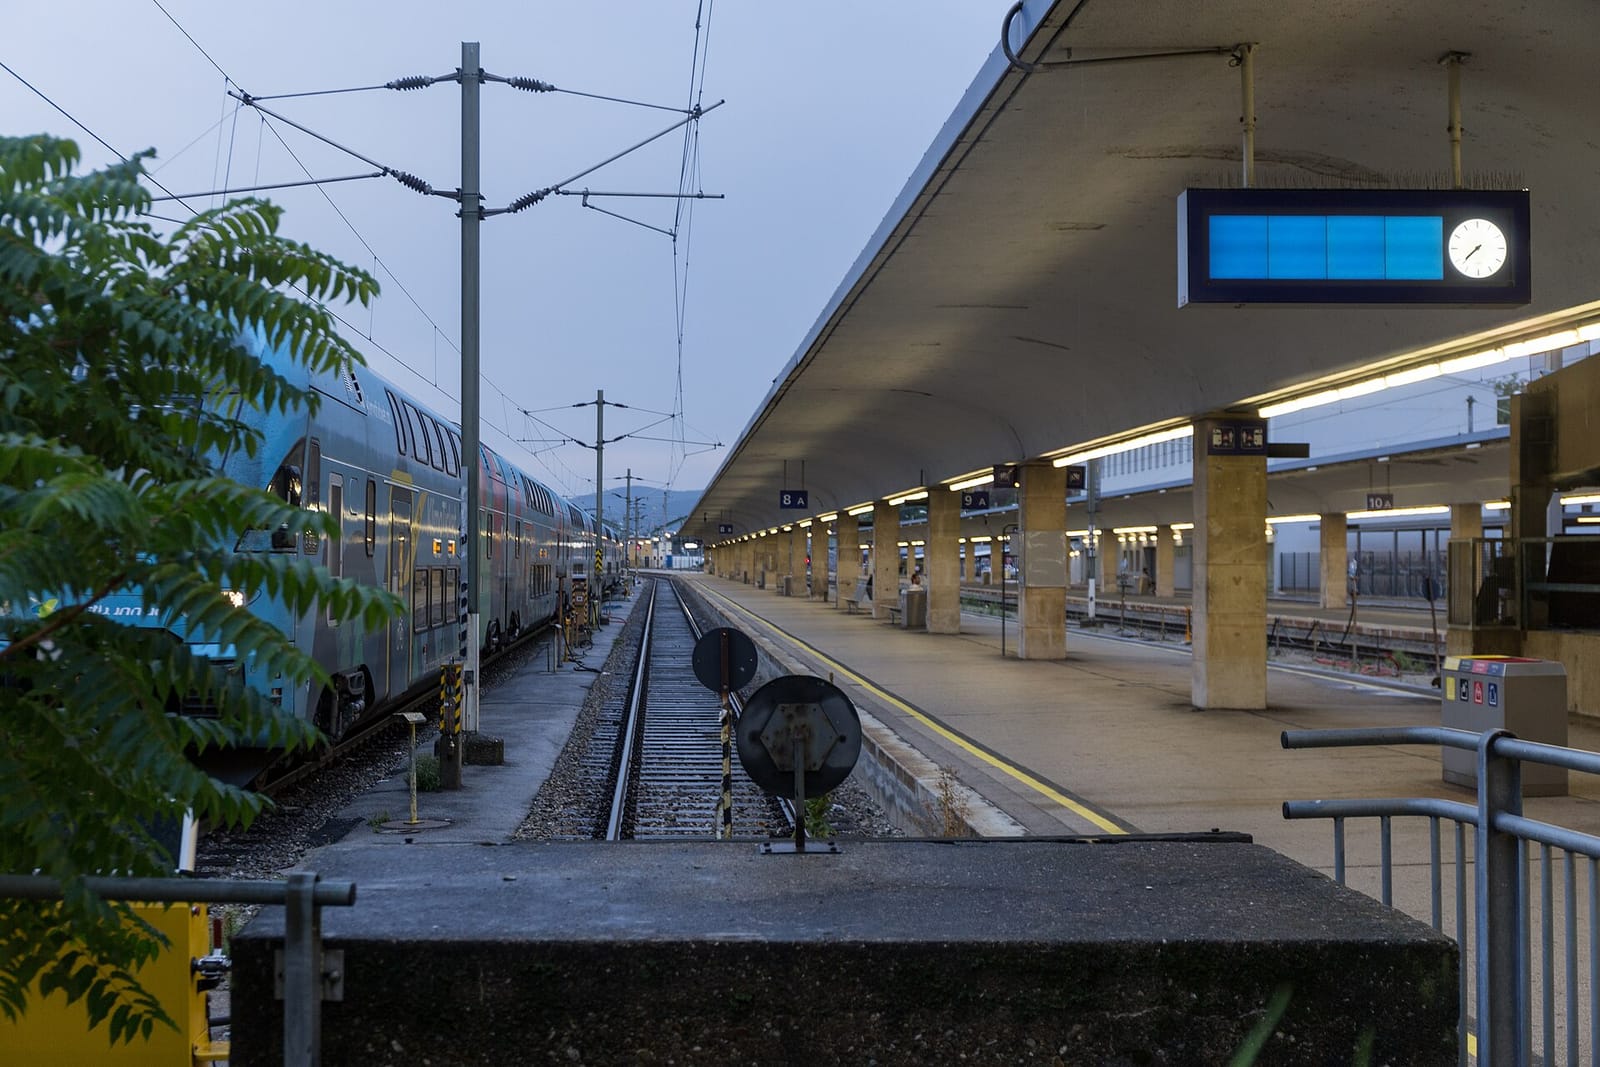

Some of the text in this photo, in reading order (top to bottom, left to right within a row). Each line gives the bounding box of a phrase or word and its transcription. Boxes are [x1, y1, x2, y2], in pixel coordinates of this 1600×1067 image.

[783, 494, 805, 505] 8 A
[965, 495, 986, 505] 9 A
[1369, 497, 1383, 509] 10
